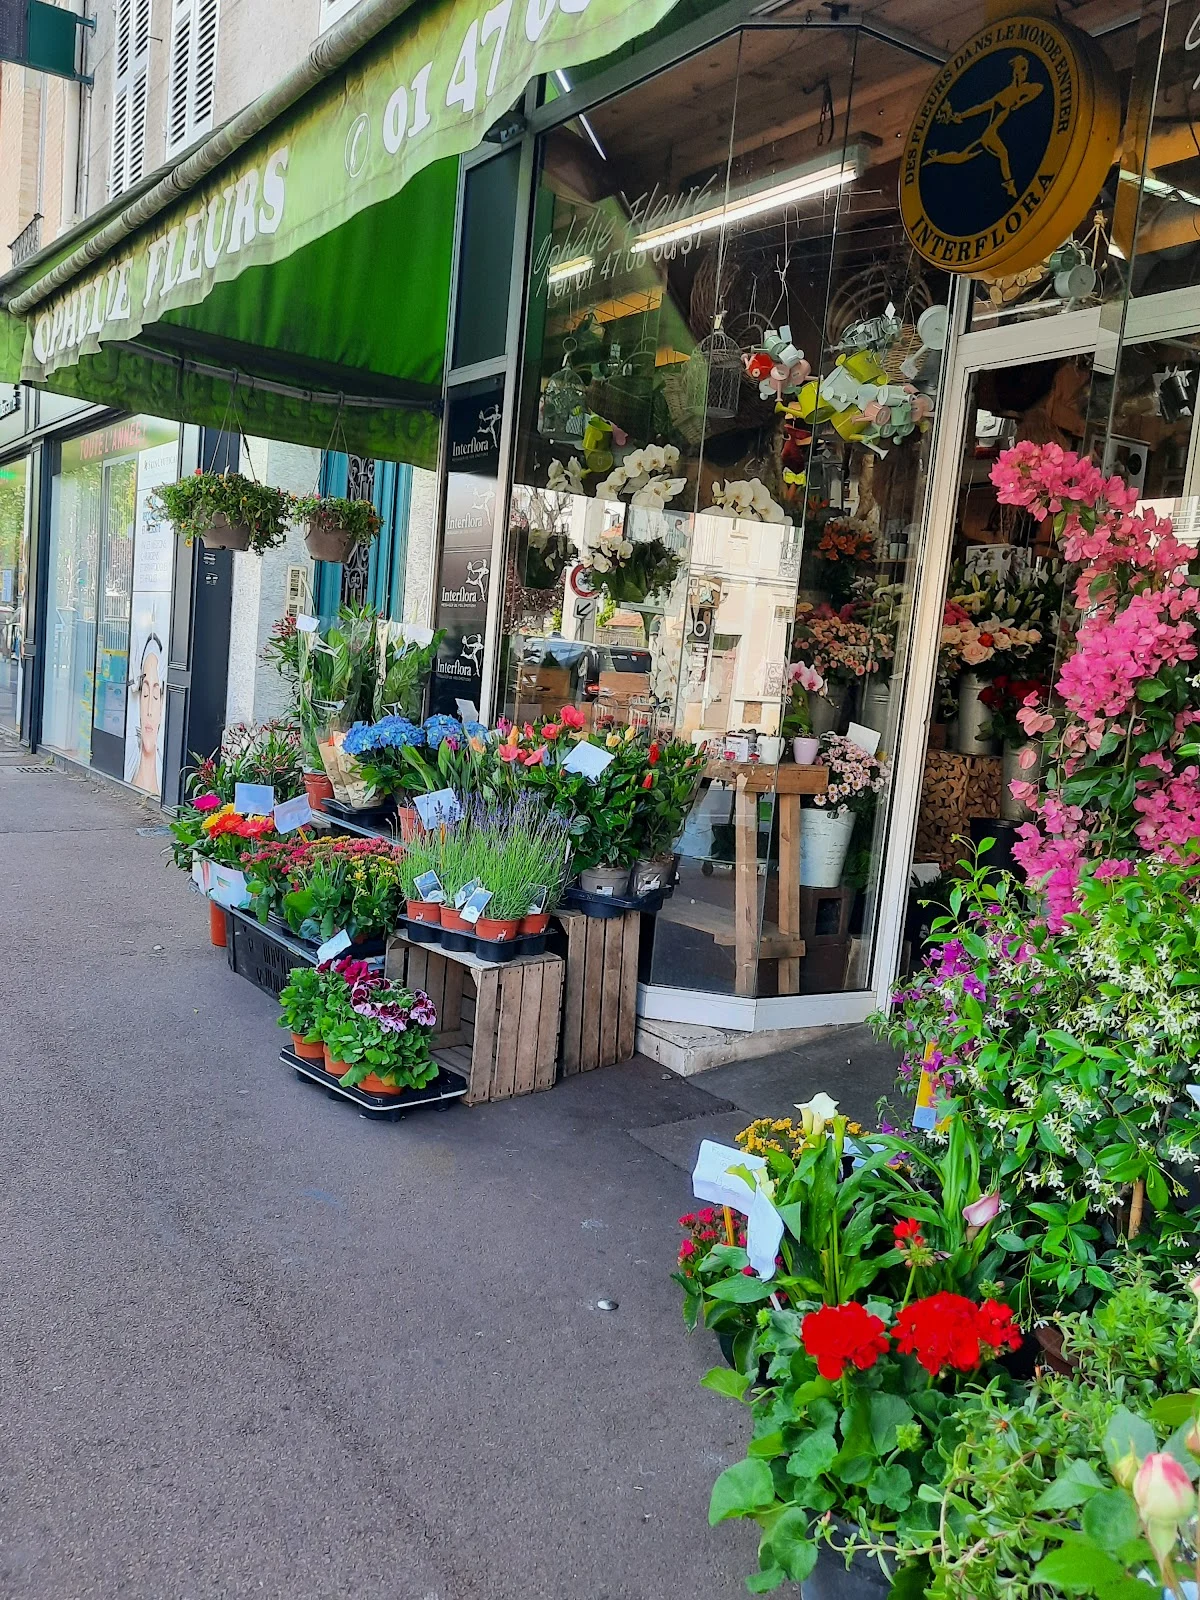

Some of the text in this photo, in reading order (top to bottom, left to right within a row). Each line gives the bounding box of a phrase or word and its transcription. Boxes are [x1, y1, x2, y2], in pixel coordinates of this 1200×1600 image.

[905, 23, 1073, 187] DES FLEURS DANS LE MONDE ENTIER
[33, 256, 134, 364] OPHELIE
[142, 145, 289, 309] FLEURS
[382, 60, 433, 155] 01
[445, 0, 512, 113] 47
[910, 172, 1055, 263] INTERFLORA
[80, 432, 104, 461] TOUTE
[452, 436, 489, 457] Interflora
[447, 512, 483, 530] Interflora
[441, 586, 477, 602] Interflora
[437, 658, 472, 676] Interflora
